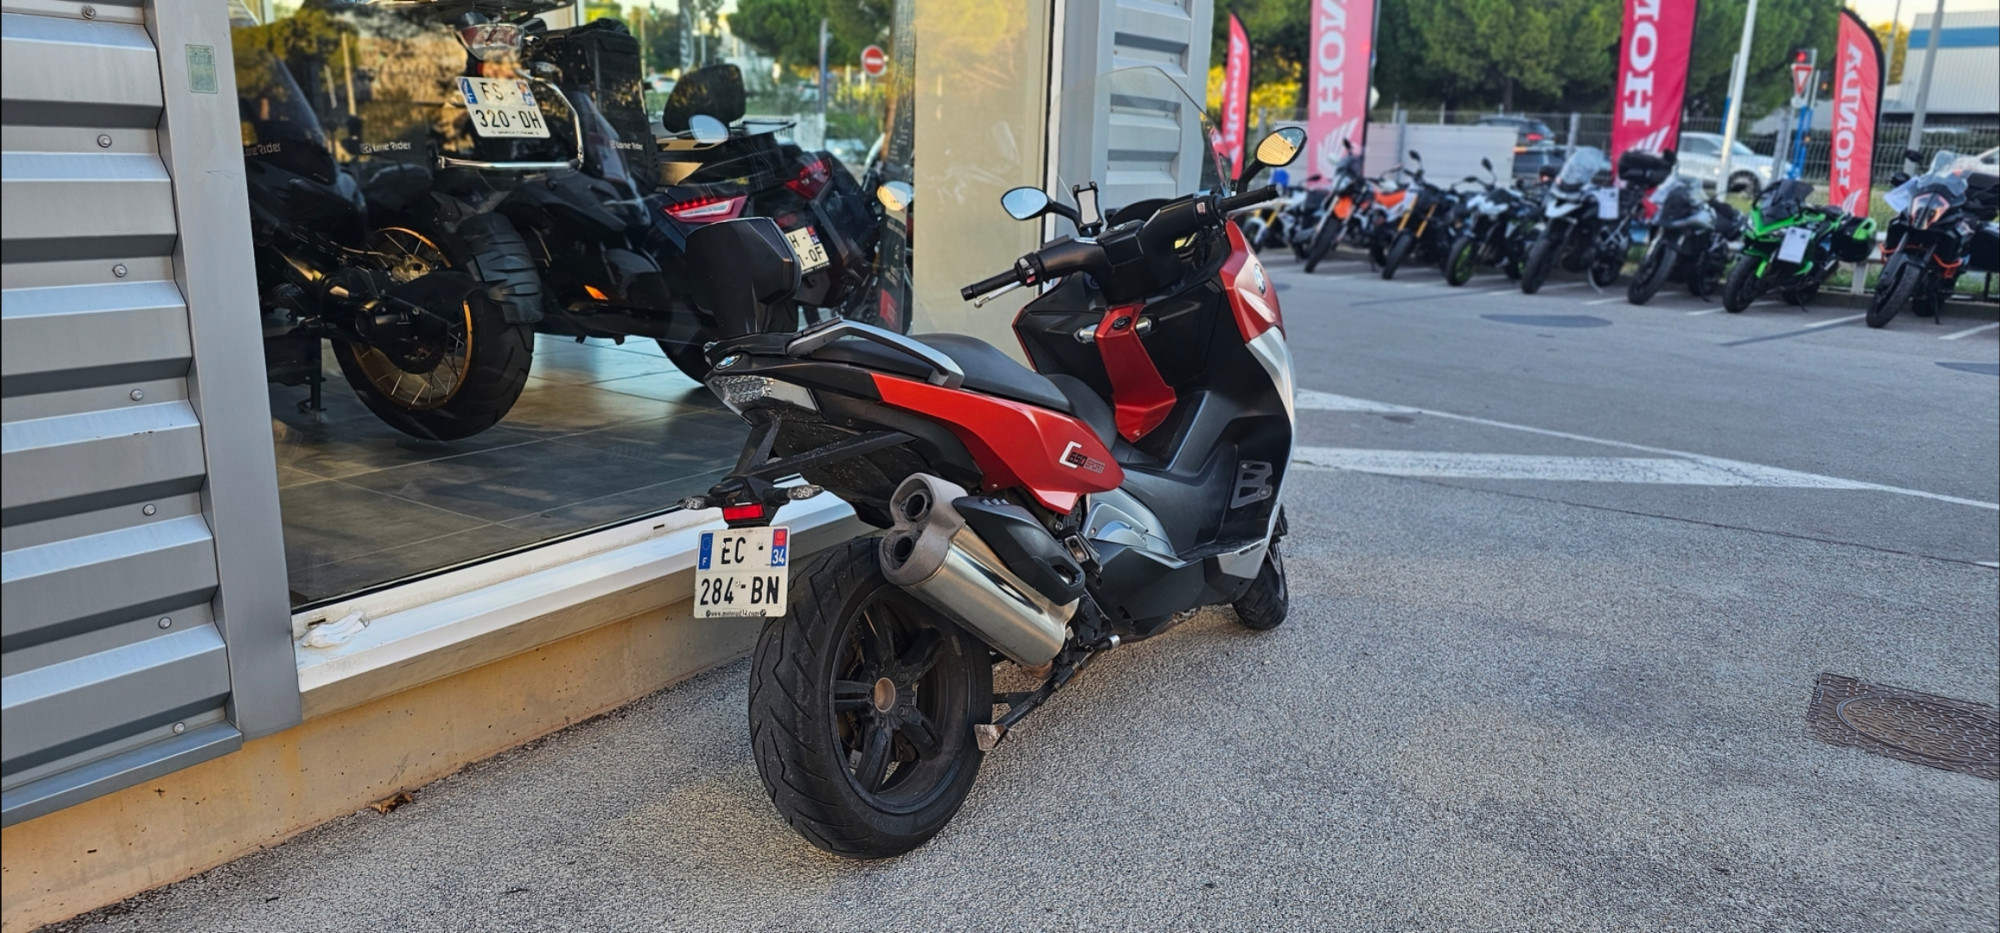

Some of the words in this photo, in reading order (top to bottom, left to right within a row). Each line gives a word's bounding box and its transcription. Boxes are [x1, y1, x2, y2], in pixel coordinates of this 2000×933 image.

[480, 81, 504, 101] FS
[475, 109, 542, 128] 320-DH
[1835, 43, 1863, 189] HONDA
[721, 536, 747, 565] EC
[772, 548, 785, 565] 34
[702, 557, 708, 566] F
[700, 576, 779, 606] 284-BN
